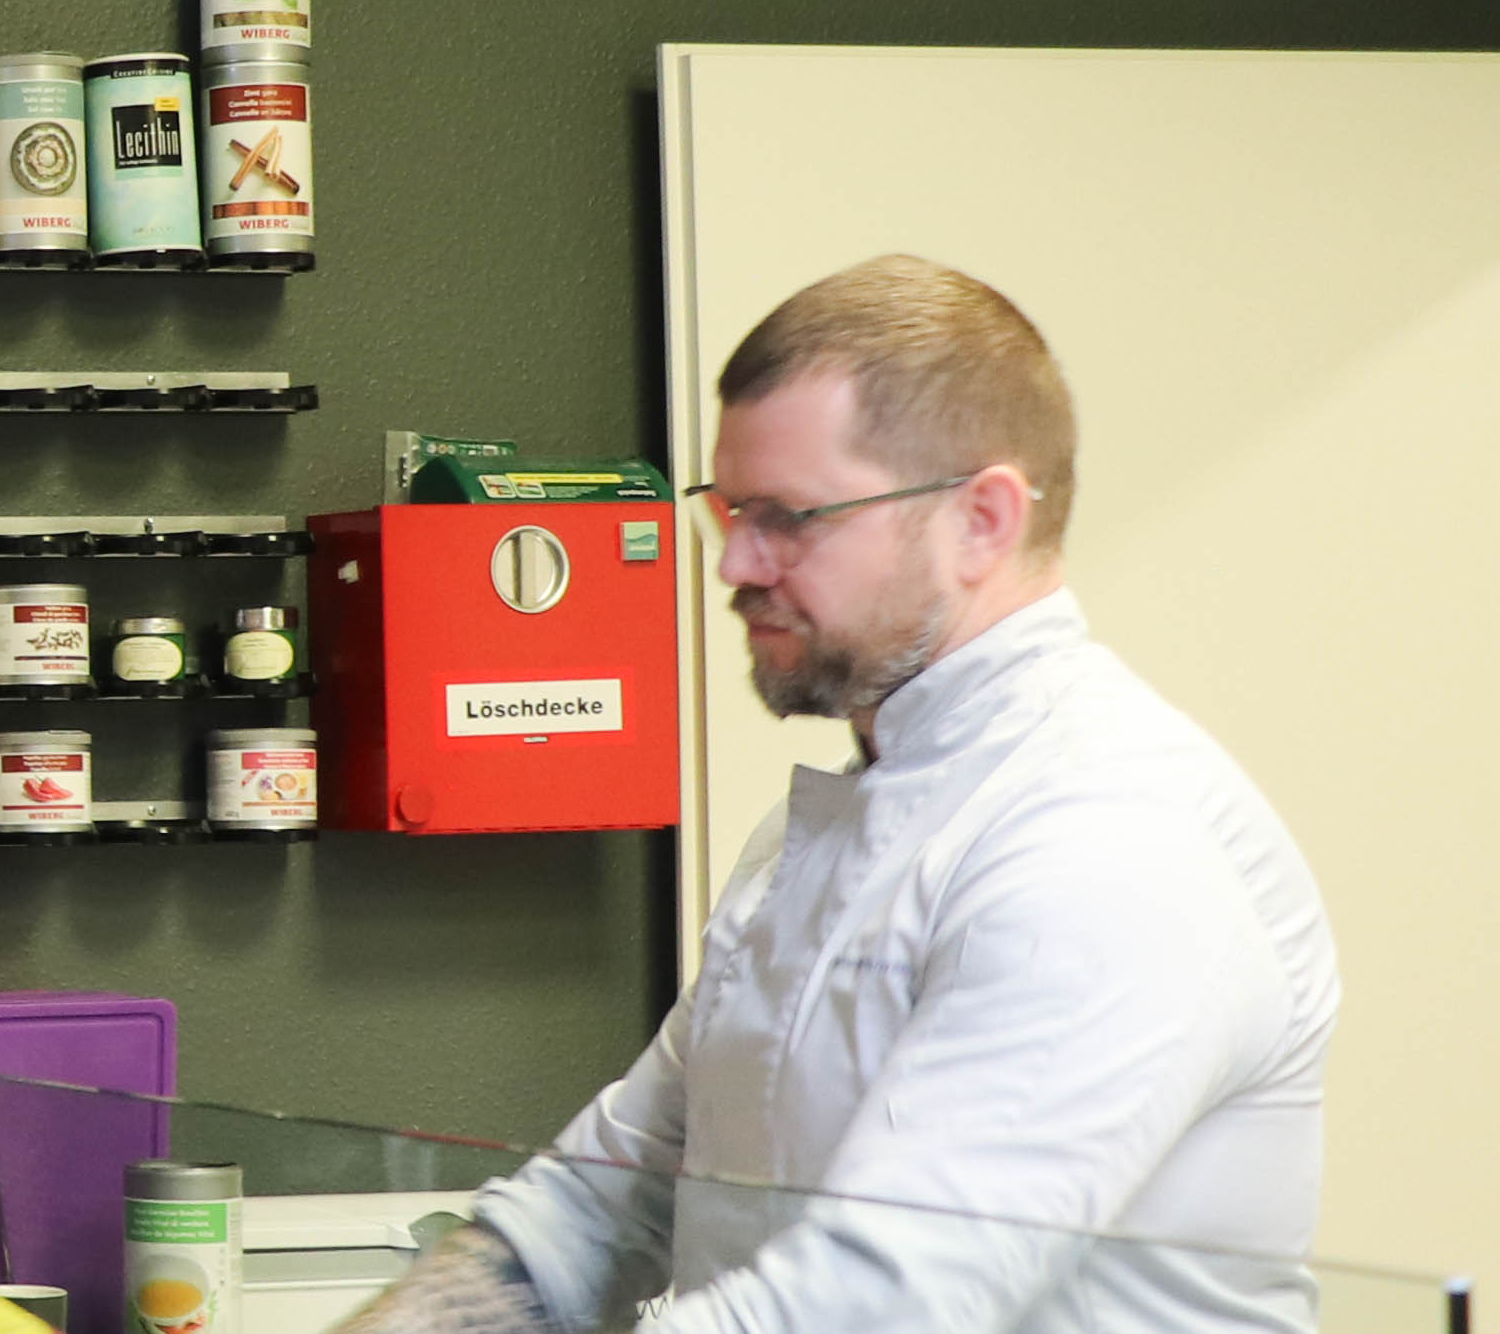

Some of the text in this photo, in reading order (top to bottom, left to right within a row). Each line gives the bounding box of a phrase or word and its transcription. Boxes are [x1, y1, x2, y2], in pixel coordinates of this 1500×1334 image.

[241, 29, 290, 39] WIBERG
[116, 117, 179, 159] Lecithin
[23, 218, 71, 228] WIBERG
[239, 220, 289, 229] WIBERG
[466, 697, 603, 719] Löschdecke
